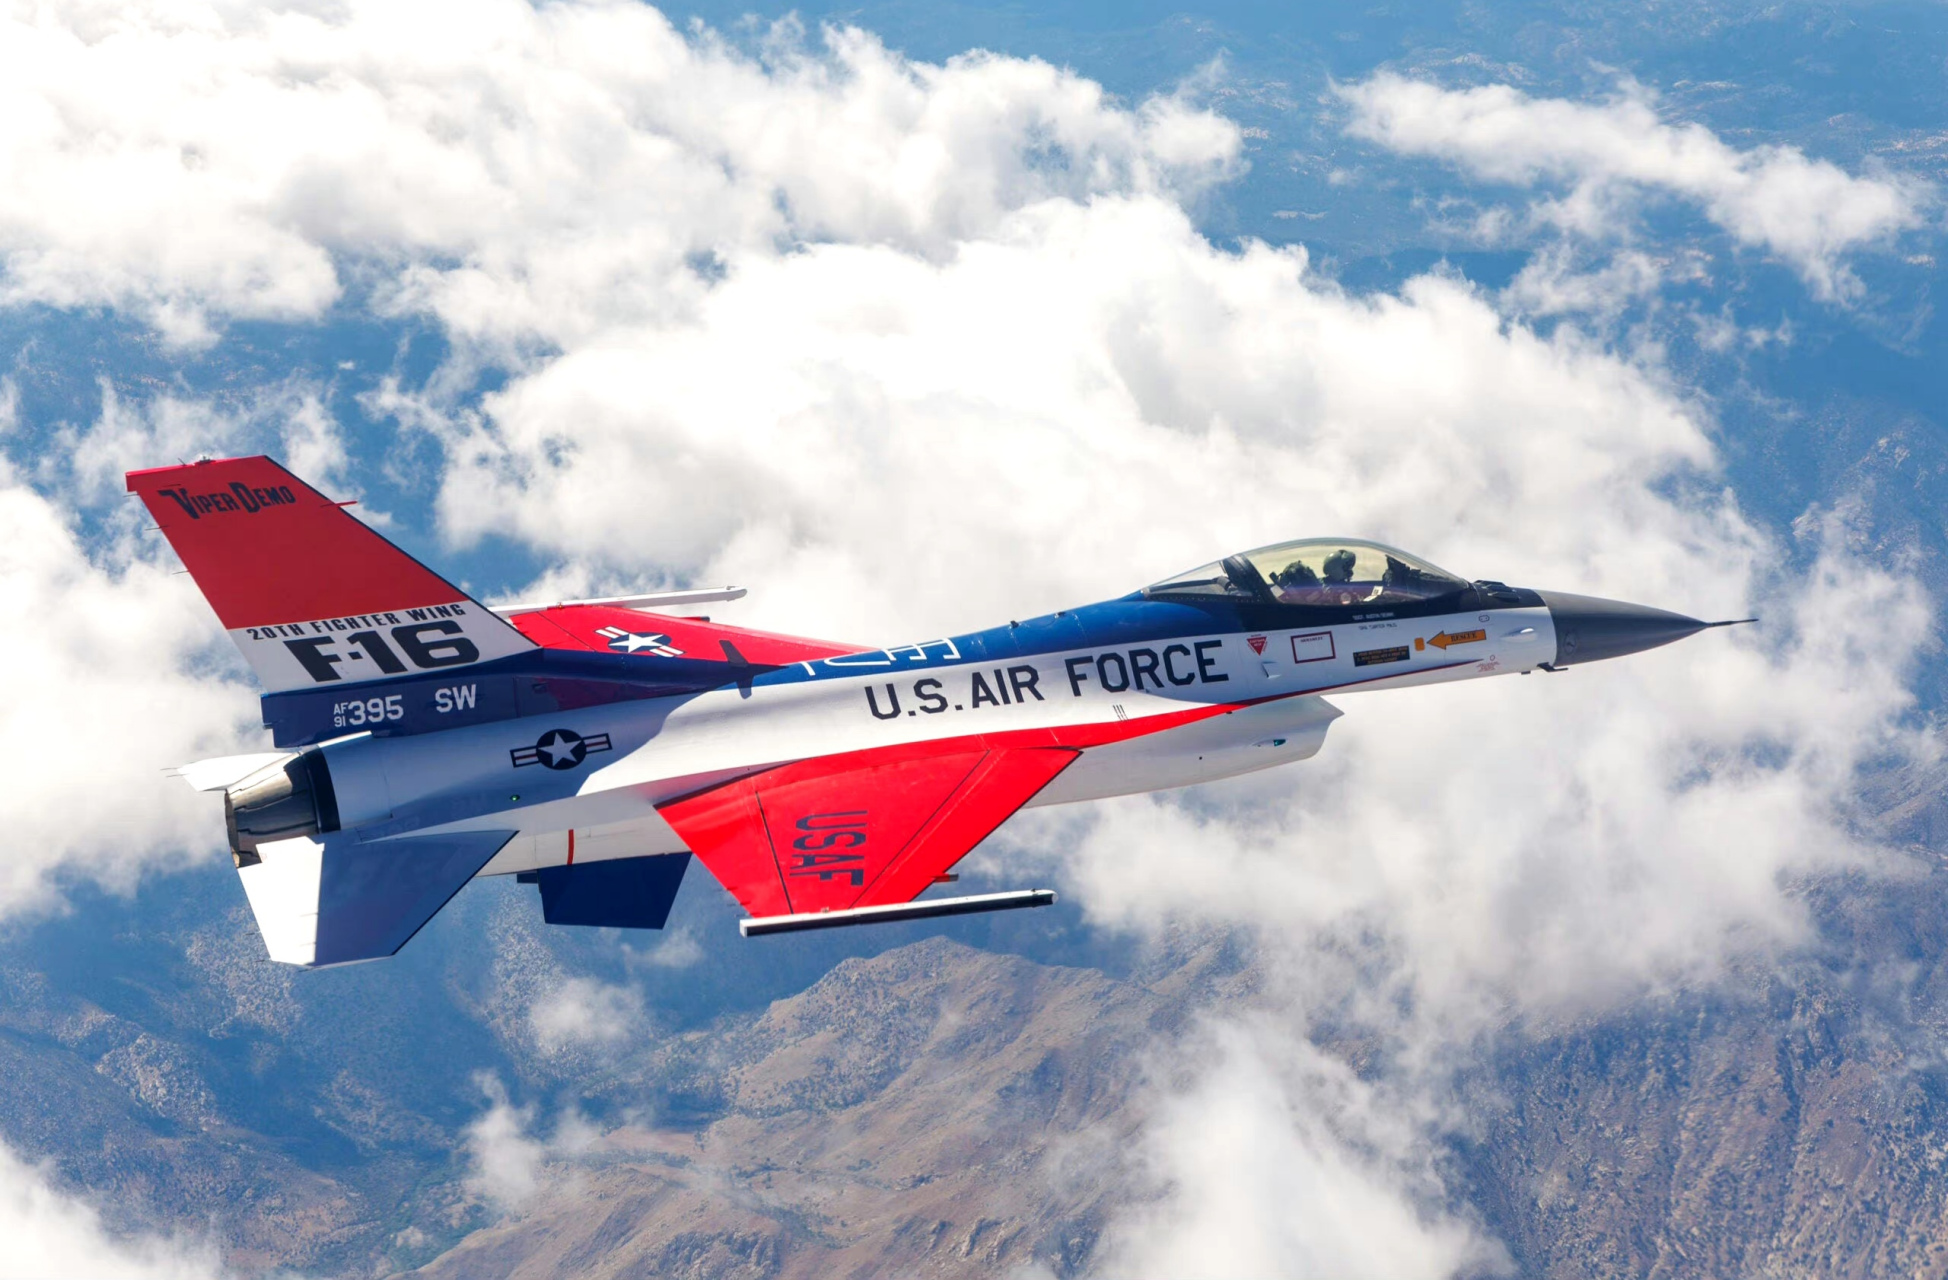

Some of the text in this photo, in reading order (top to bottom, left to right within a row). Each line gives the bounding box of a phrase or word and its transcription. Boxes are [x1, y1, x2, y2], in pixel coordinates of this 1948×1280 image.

[246, 602, 466, 641] 20TH FIGHTER WING
[1451, 632, 1477, 642] RESCUE
[283, 620, 480, 683] F-16
[864, 679, 963, 721] U.S.
[971, 664, 1045, 709] AIR
[1064, 640, 1230, 698] FORCE
[333, 702, 348, 714] AF
[348, 694, 404, 726] 395
[434, 684, 477, 714] SW
[334, 716, 347, 728] 91
[790, 811, 868, 886] USAF
